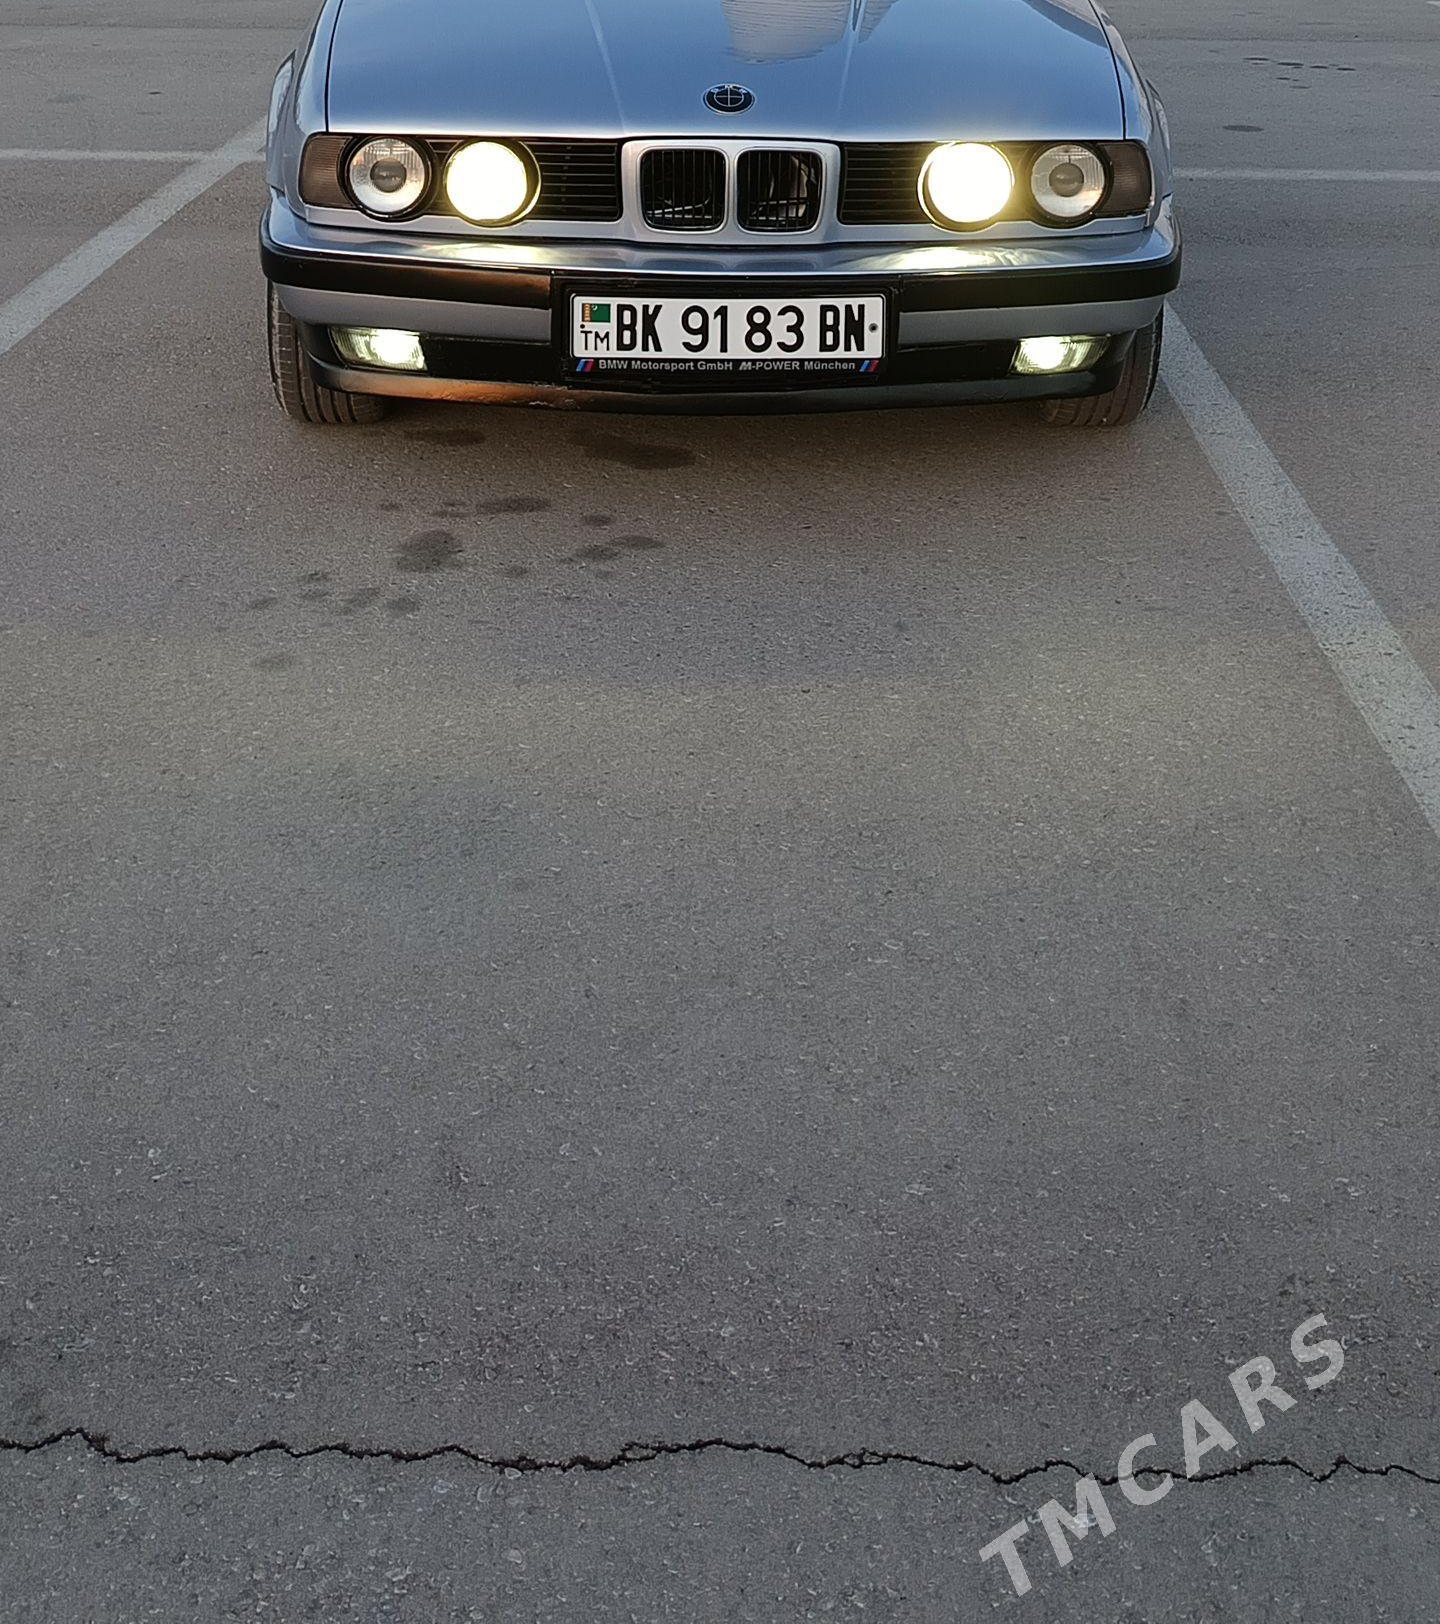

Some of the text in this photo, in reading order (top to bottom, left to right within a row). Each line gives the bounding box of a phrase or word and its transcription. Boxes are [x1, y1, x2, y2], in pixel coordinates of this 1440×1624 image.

[616, 303, 866, 353] BK 91 83 BN
[580, 330, 610, 352] TM
[598, 359, 628, 370] BMW
[631, 360, 694, 372] Motorsport
[697, 360, 733, 370] GmbH
[804, 360, 856, 370] München
